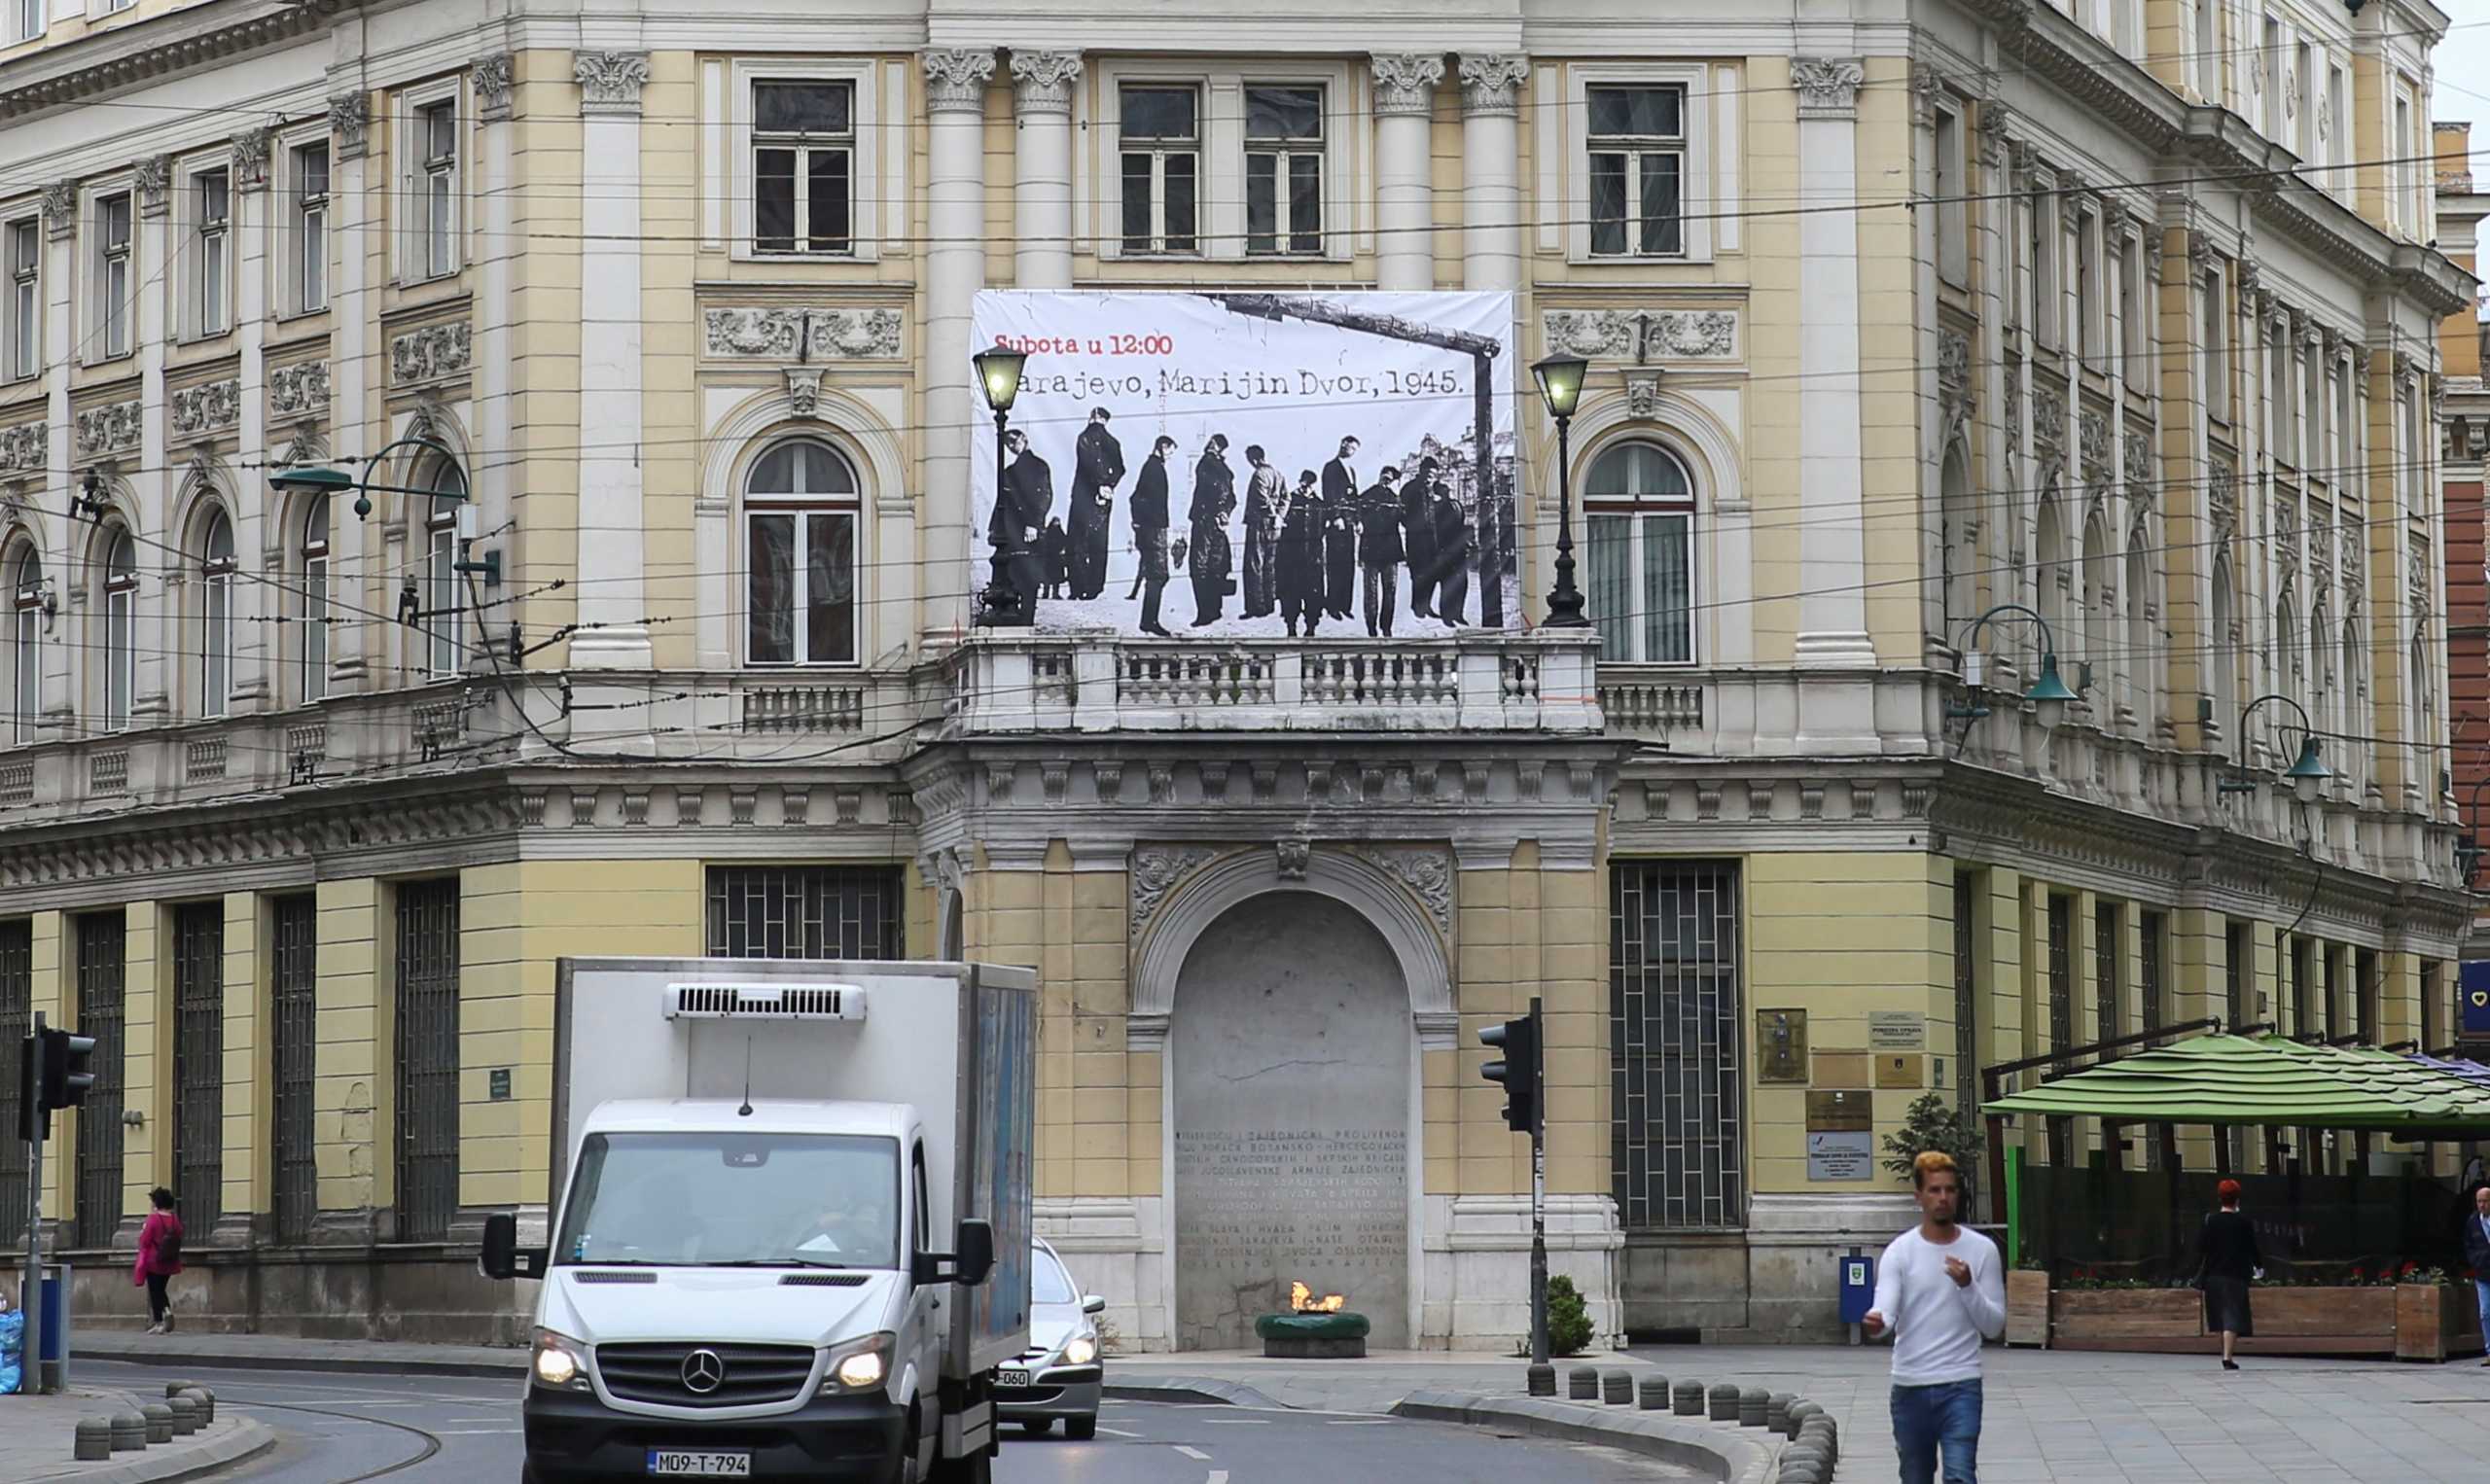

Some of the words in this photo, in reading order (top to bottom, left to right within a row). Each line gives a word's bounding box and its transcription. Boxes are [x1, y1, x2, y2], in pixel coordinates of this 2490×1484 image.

[995, 335, 1079, 355] Subota
[1088, 340, 1103, 355] u
[1110, 336, 1173, 355] 12:00
[1016, 371, 1152, 400] arajevo,
[1158, 369, 1290, 401] Marijin
[1298, 370, 1379, 398] Dvor,
[1386, 370, 1464, 396] 1945.
[658, 1455, 746, 1472] M09-T-794
